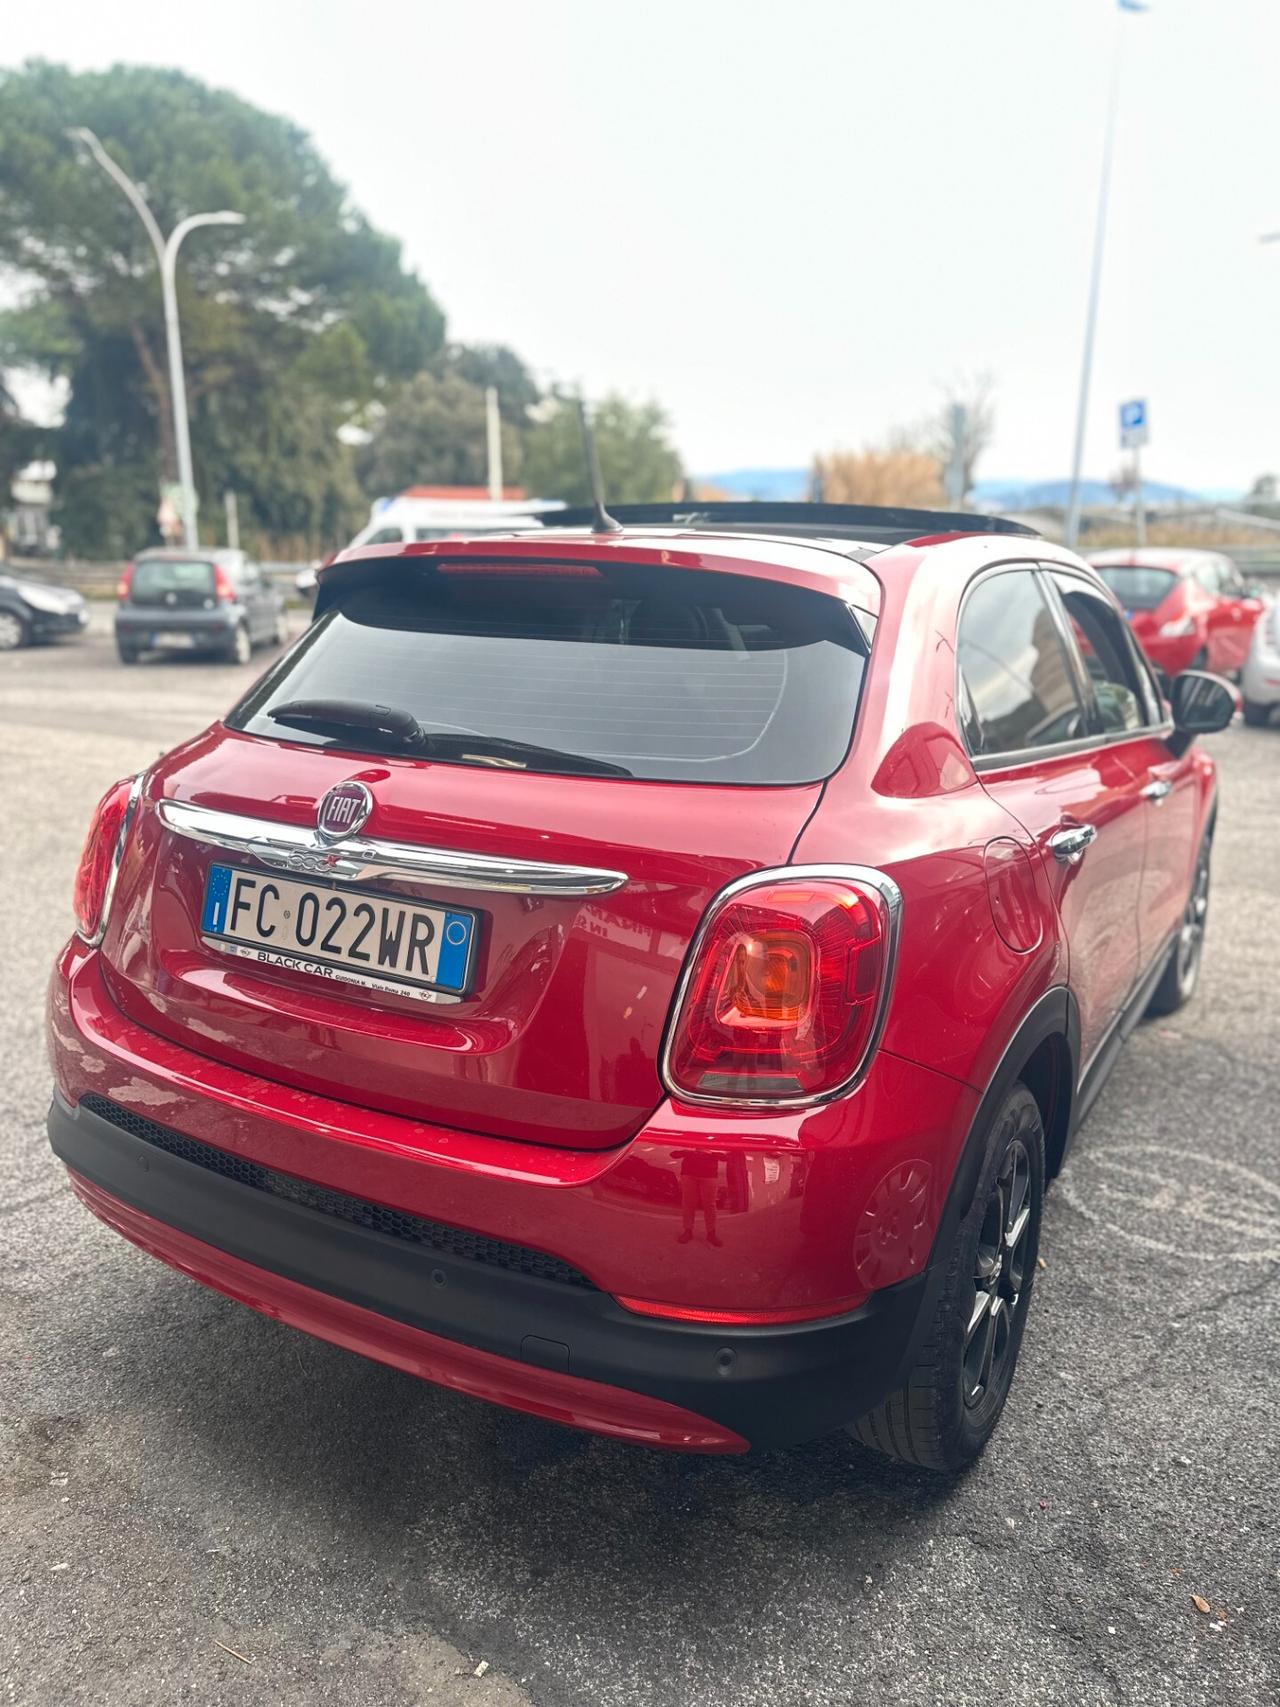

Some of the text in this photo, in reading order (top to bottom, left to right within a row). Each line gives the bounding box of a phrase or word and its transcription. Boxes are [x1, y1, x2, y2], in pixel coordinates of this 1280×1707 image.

[326, 796, 361, 824] FIAT
[213, 902, 220, 925] I
[230, 878, 435, 974] FC 022WR
[257, 951, 302, 970] BLACK
[303, 963, 333, 978] CAR
